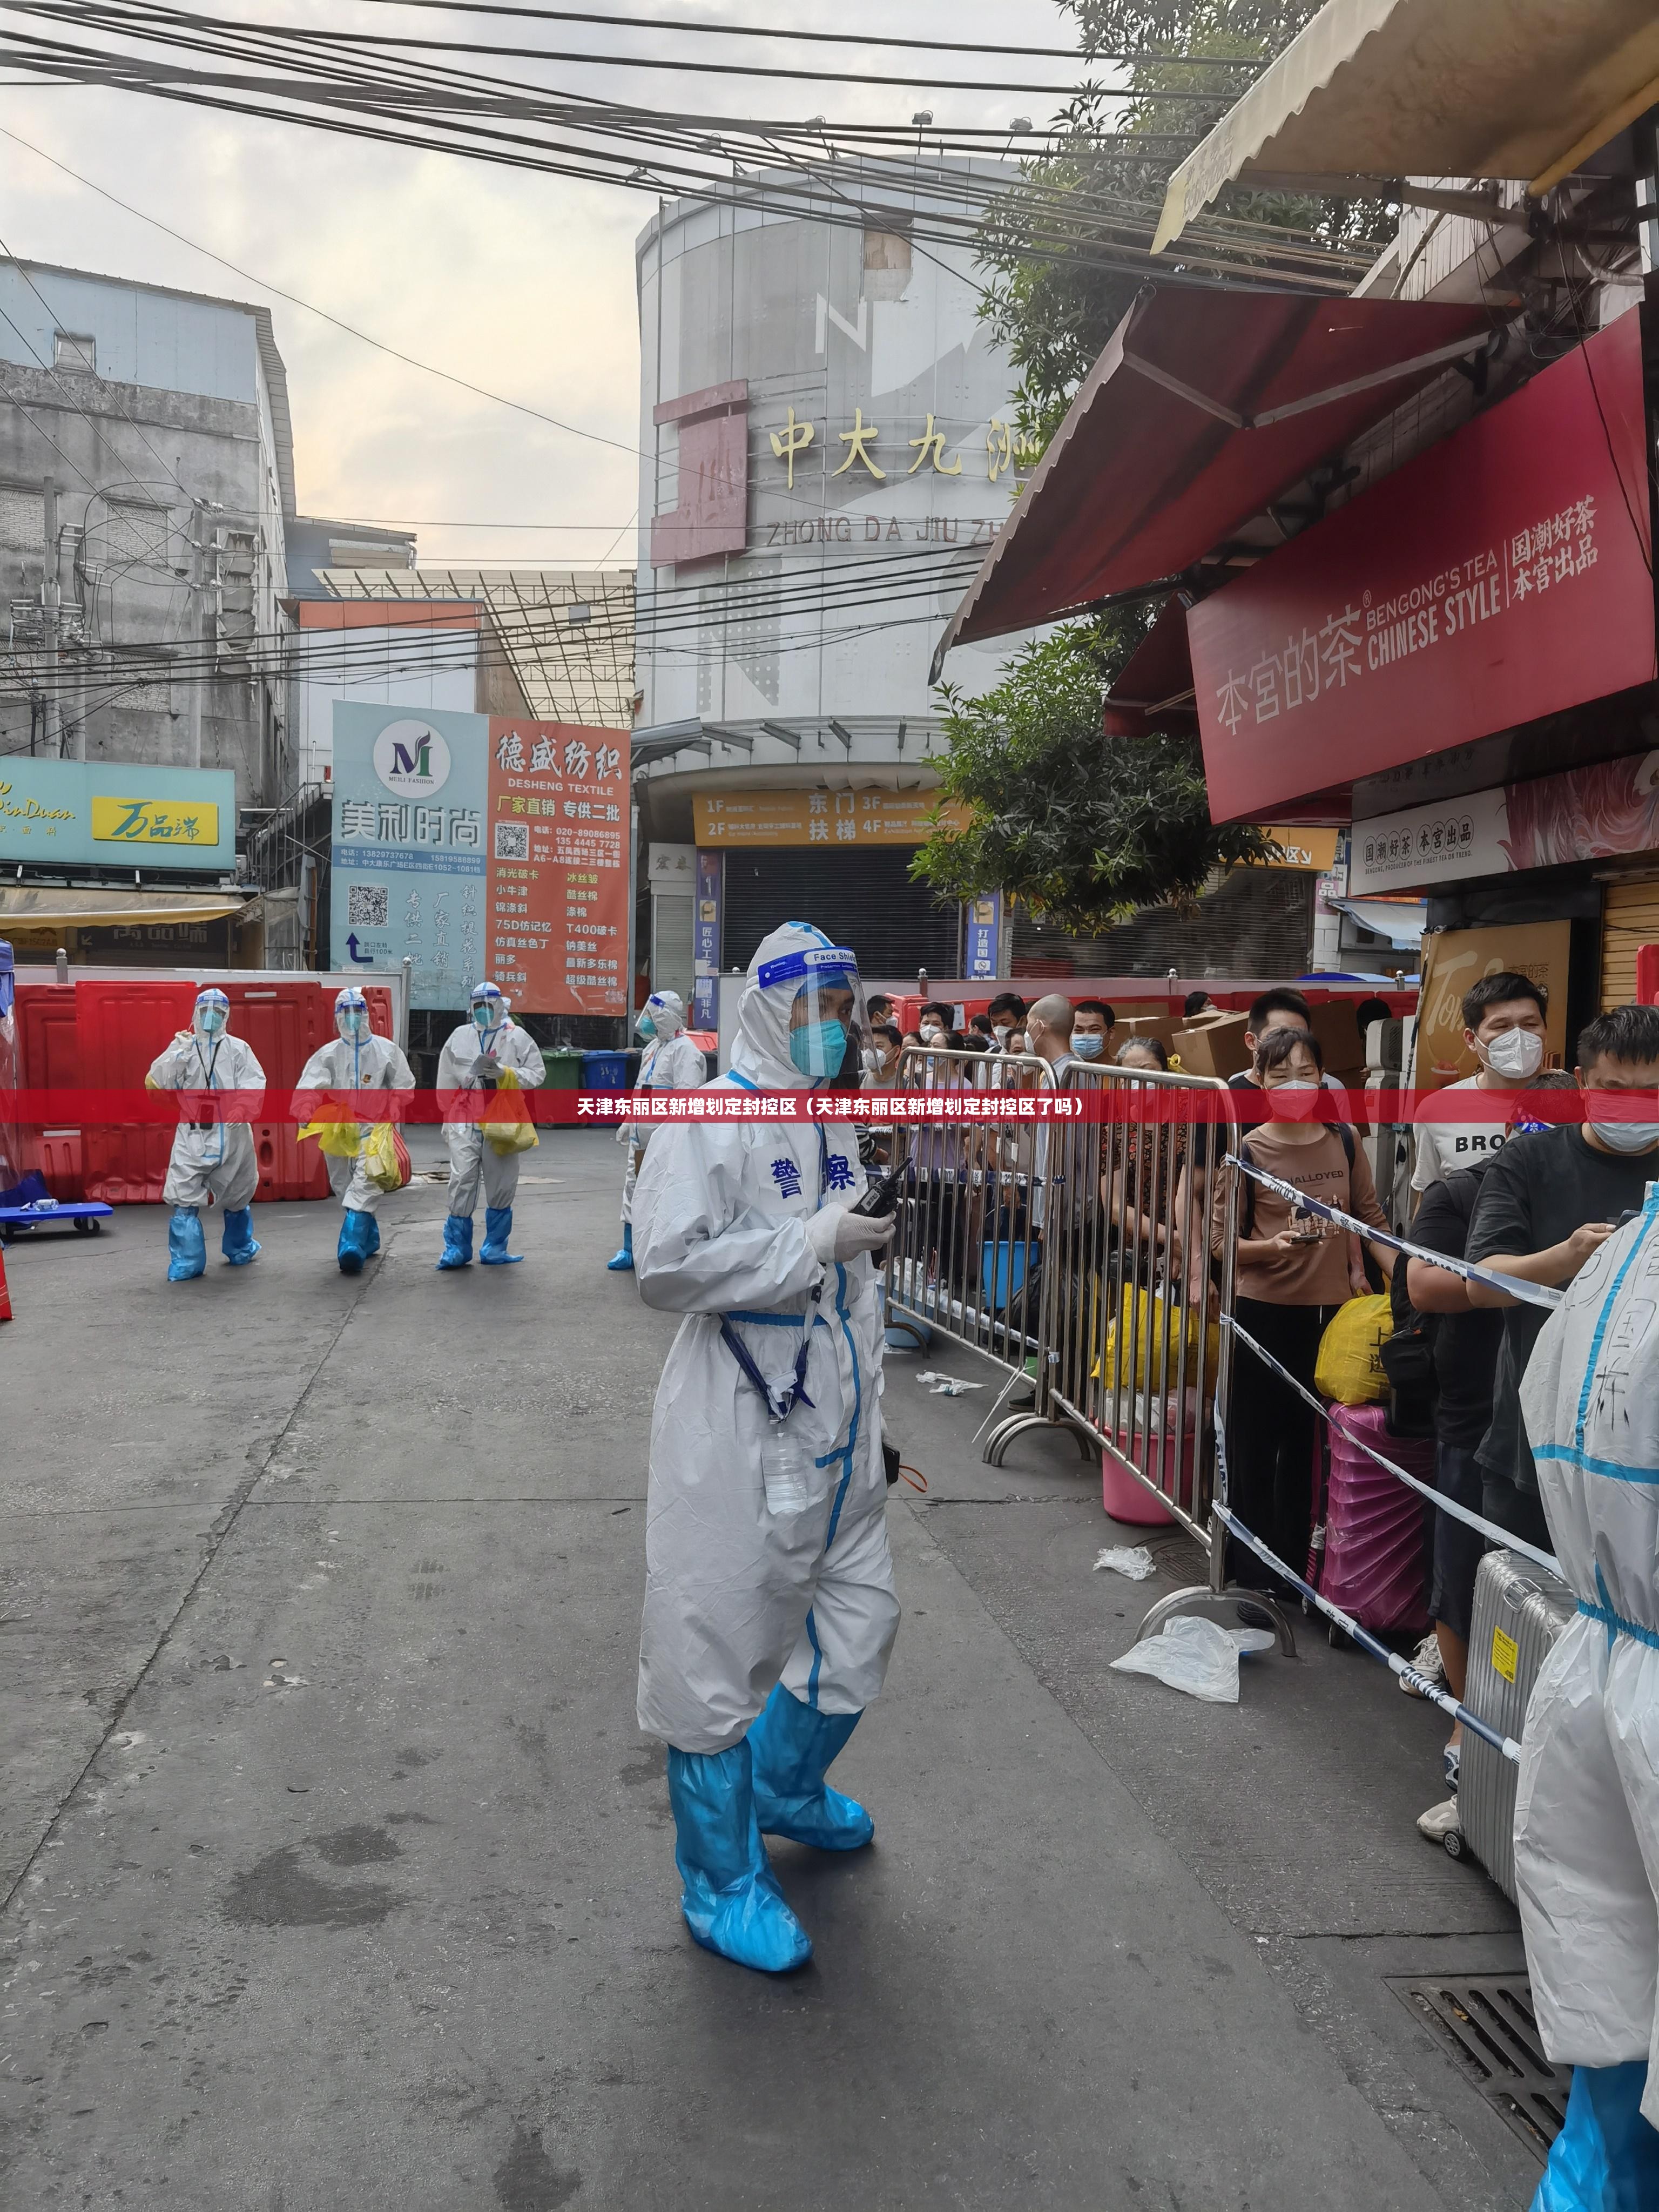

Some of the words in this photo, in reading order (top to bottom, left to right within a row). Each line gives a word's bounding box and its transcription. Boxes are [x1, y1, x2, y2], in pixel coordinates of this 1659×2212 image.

[766, 517, 852, 547] ZHONG
[864, 517, 902, 541] DA
[916, 516, 958, 542] JIU
[1512, 495, 1597, 567] 国潮好茶
[1512, 534, 1597, 602] 本宫出品
[1365, 563, 1460, 630] BENGONG'S
[1464, 549, 1497, 581] TEA
[1367, 605, 1438, 671] CHINESE
[1446, 574, 1501, 635] STYLE
[495, 730, 622, 781] 德盛纺织
[508, 778, 563, 791] DESHENG
[568, 784, 613, 796] TEXTILE
[497, 795, 555, 817] 厂家直销
[563, 800, 620, 822] 专供二批
[707, 800, 724, 813] 1F
[809, 792, 855, 814] 东门
[862, 797, 881, 810] 3F
[111, 801, 200, 841] 万品端
[341, 799, 481, 847] 美利时尚
[708, 822, 725, 836] 2F
[863, 820, 881, 833] 4F
[809, 819, 856, 841] 扶梯
[599, 840, 620, 849] 7728
[1366, 836, 1411, 862] 国潮好茶
[363, 851, 413, 859] 13829737678
[496, 867, 539, 880] 消光破卡
[567, 906, 587, 918] 涤棉
[433, 892, 450, 968] 厂家直销
[495, 920, 551, 933] 75D仿记忆
[567, 923, 618, 936] T400破卡
[461, 885, 477, 989] 针织提花系列
[495, 936, 549, 949] 仿真丝色丁
[495, 954, 516, 965] 丽多
[566, 957, 618, 970] 最新多乐棉
[814, 953, 837, 962] Face
[495, 971, 527, 983] 骑兵斜
[565, 974, 618, 987] 超级酷丝棉
[771, 1154, 855, 1199] 警察
